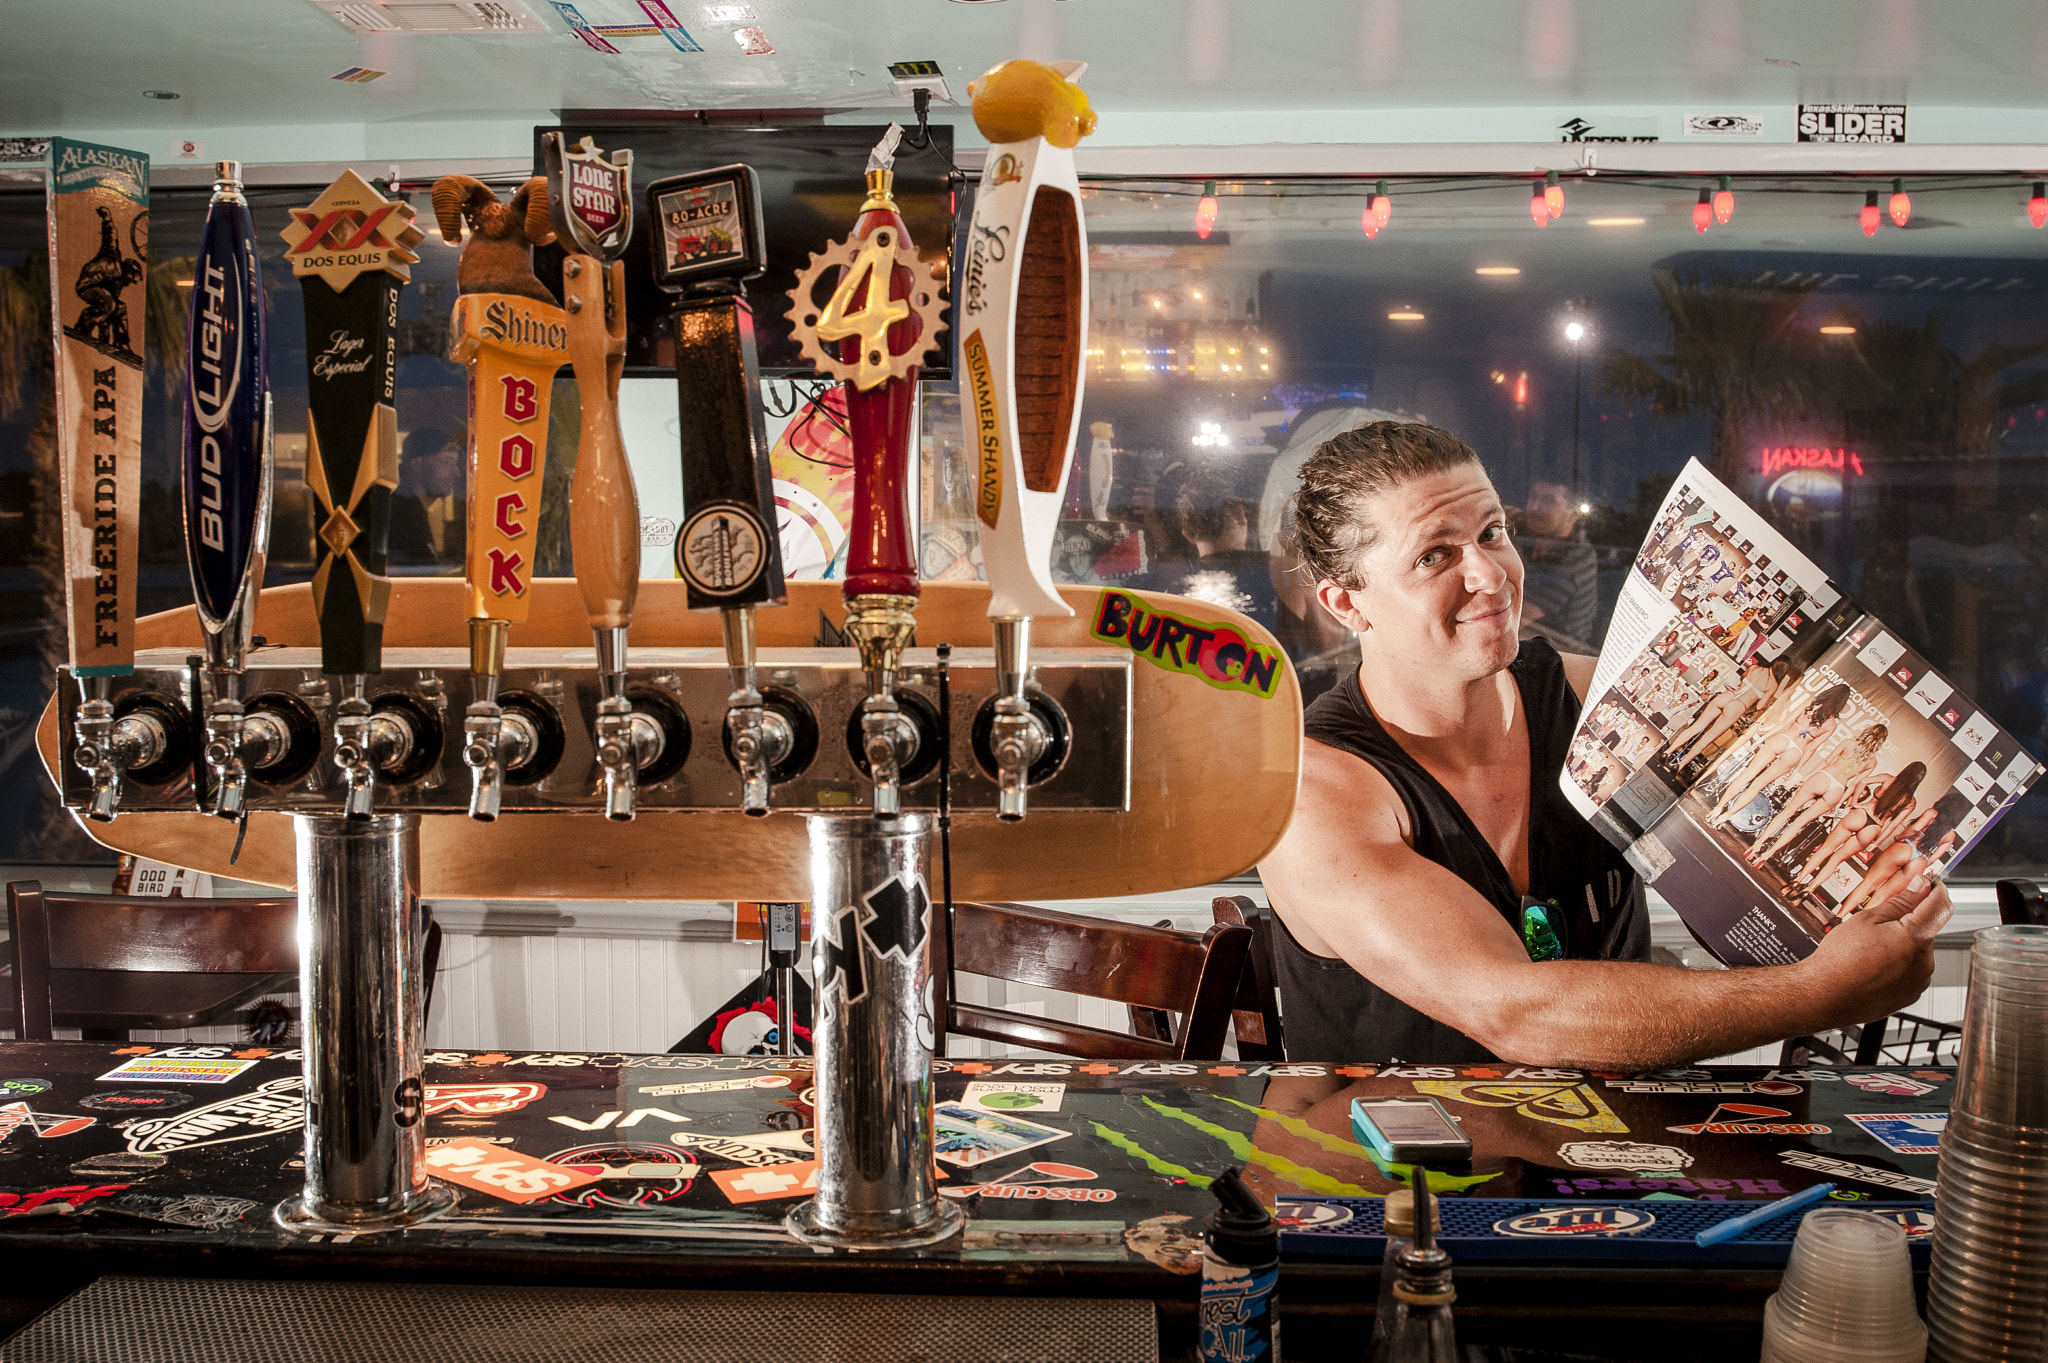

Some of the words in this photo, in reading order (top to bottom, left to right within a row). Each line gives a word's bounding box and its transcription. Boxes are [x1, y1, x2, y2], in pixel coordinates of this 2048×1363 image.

[1802, 104, 1905, 115] TexasSkiRanch.com
[1800, 113, 1904, 136] SLIDER
[1834, 134, 1895, 144] BOARD
[57, 147, 147, 187] ALASKAN
[572, 162, 614, 192] LONE
[573, 186, 616, 216] STAR
[671, 201, 729, 225] 80-ACRE
[586, 212, 606, 224] BEER
[303, 255, 334, 268] DOS
[338, 253, 381, 266] EQUIS
[388, 287, 399, 329] DOS
[815, 225, 910, 392] 4
[198, 254, 225, 407] LIGHT
[480, 301, 568, 351] Shiner
[323, 330, 366, 358] Lager
[313, 354, 374, 382] Especial
[385, 337, 396, 399] EQUIS
[94, 365, 117, 440] APA
[967, 343, 995, 432] SUMMER
[981, 434, 1000, 512] SHANDY
[201, 436, 225, 552] BUD
[486, 373, 538, 597] BOCK
[94, 455, 118, 649] FREERIDE
[1096, 591, 1279, 693] BURTON
[137, 882, 164, 893] BIRD
[140, 870, 167, 882] ODD
[1750, 905, 1777, 931] THANK'S
[145, 1046, 233, 1058] SPY
[503, 1053, 590, 1067] SPY
[991, 1062, 1073, 1075] SPY
[1118, 1062, 1199, 1076] SPY
[1248, 1064, 1328, 1078] SPY
[1376, 1065, 1456, 1079] SPY
[1505, 1066, 1585, 1079] SPY
[1763, 1069, 1843, 1082] SPY
[215, 1094, 303, 1119] THE
[1666, 1122, 1833, 1134] OBSCURA
[1580, 1157, 1675, 1166] REPUBLIC
[447, 1160, 572, 1195] SPY
[1551, 1178, 1790, 1194] Haters!
[940, 1184, 1117, 1202] OBSCURA
